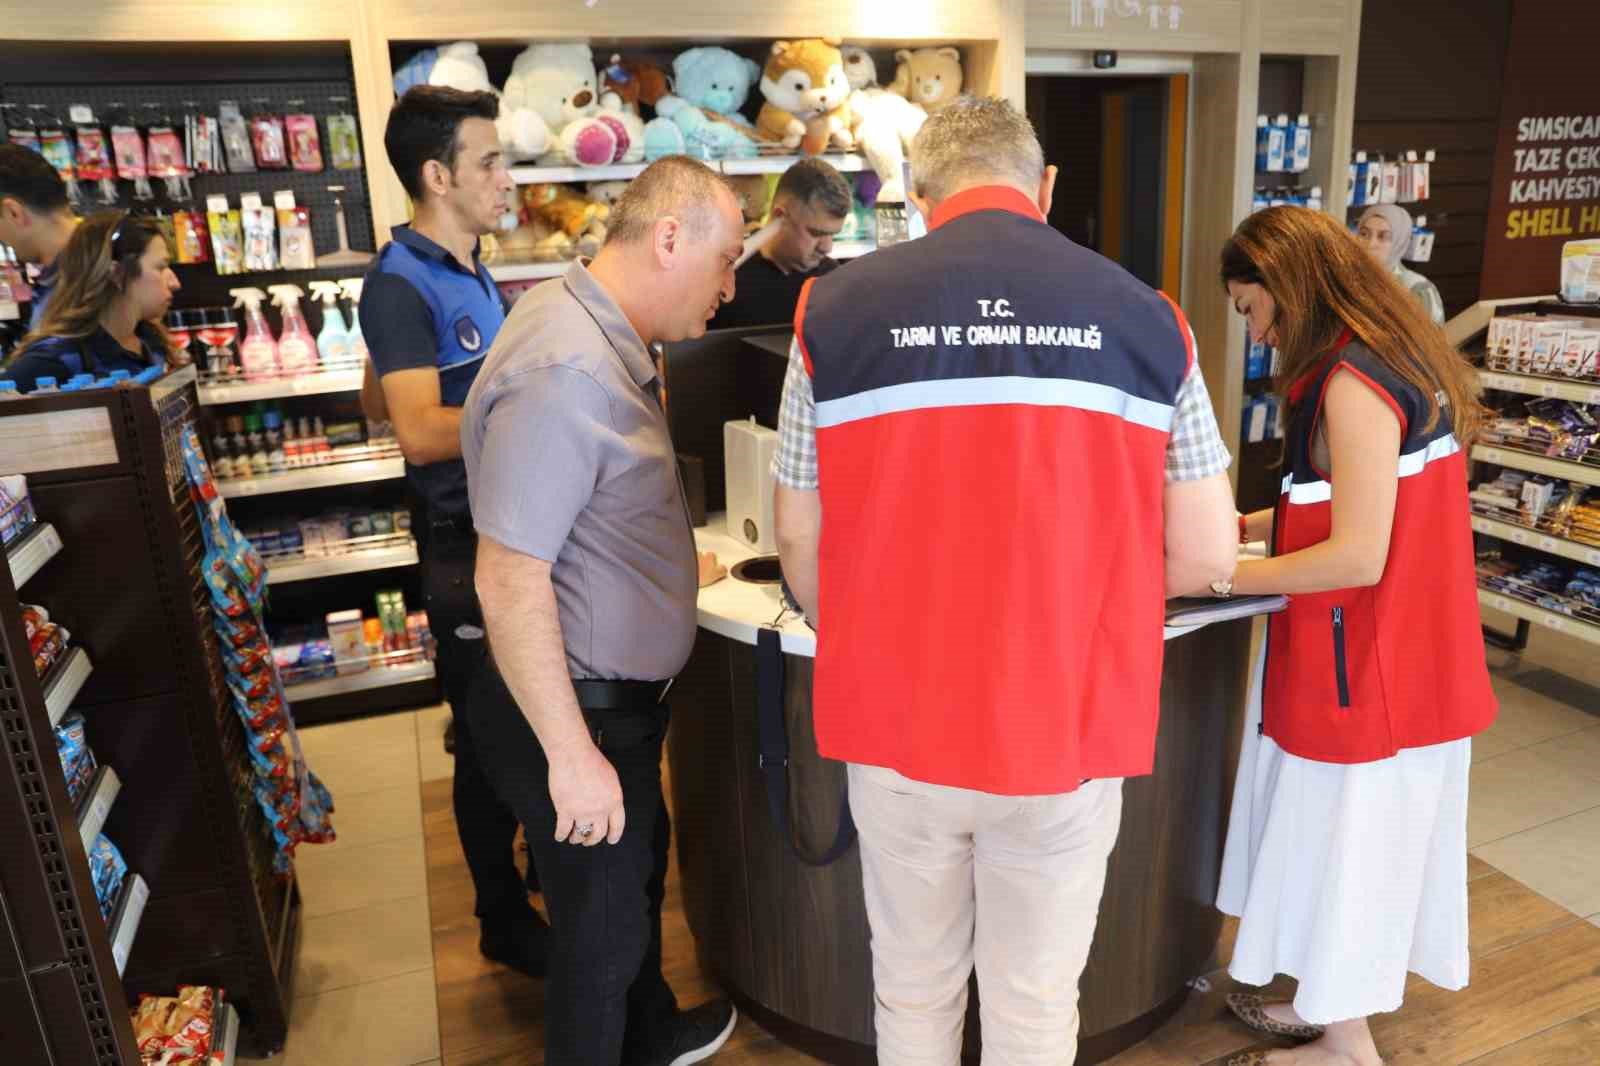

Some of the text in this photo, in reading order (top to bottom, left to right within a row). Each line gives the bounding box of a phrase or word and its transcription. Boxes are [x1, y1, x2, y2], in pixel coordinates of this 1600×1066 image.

[1514, 148, 1562, 172] TAZE
[1505, 207, 1573, 239] SHELL
[977, 299, 1015, 317] T.C.
[890, 324, 1102, 350] TARIM VE ORMAN BAKANLIĞI
